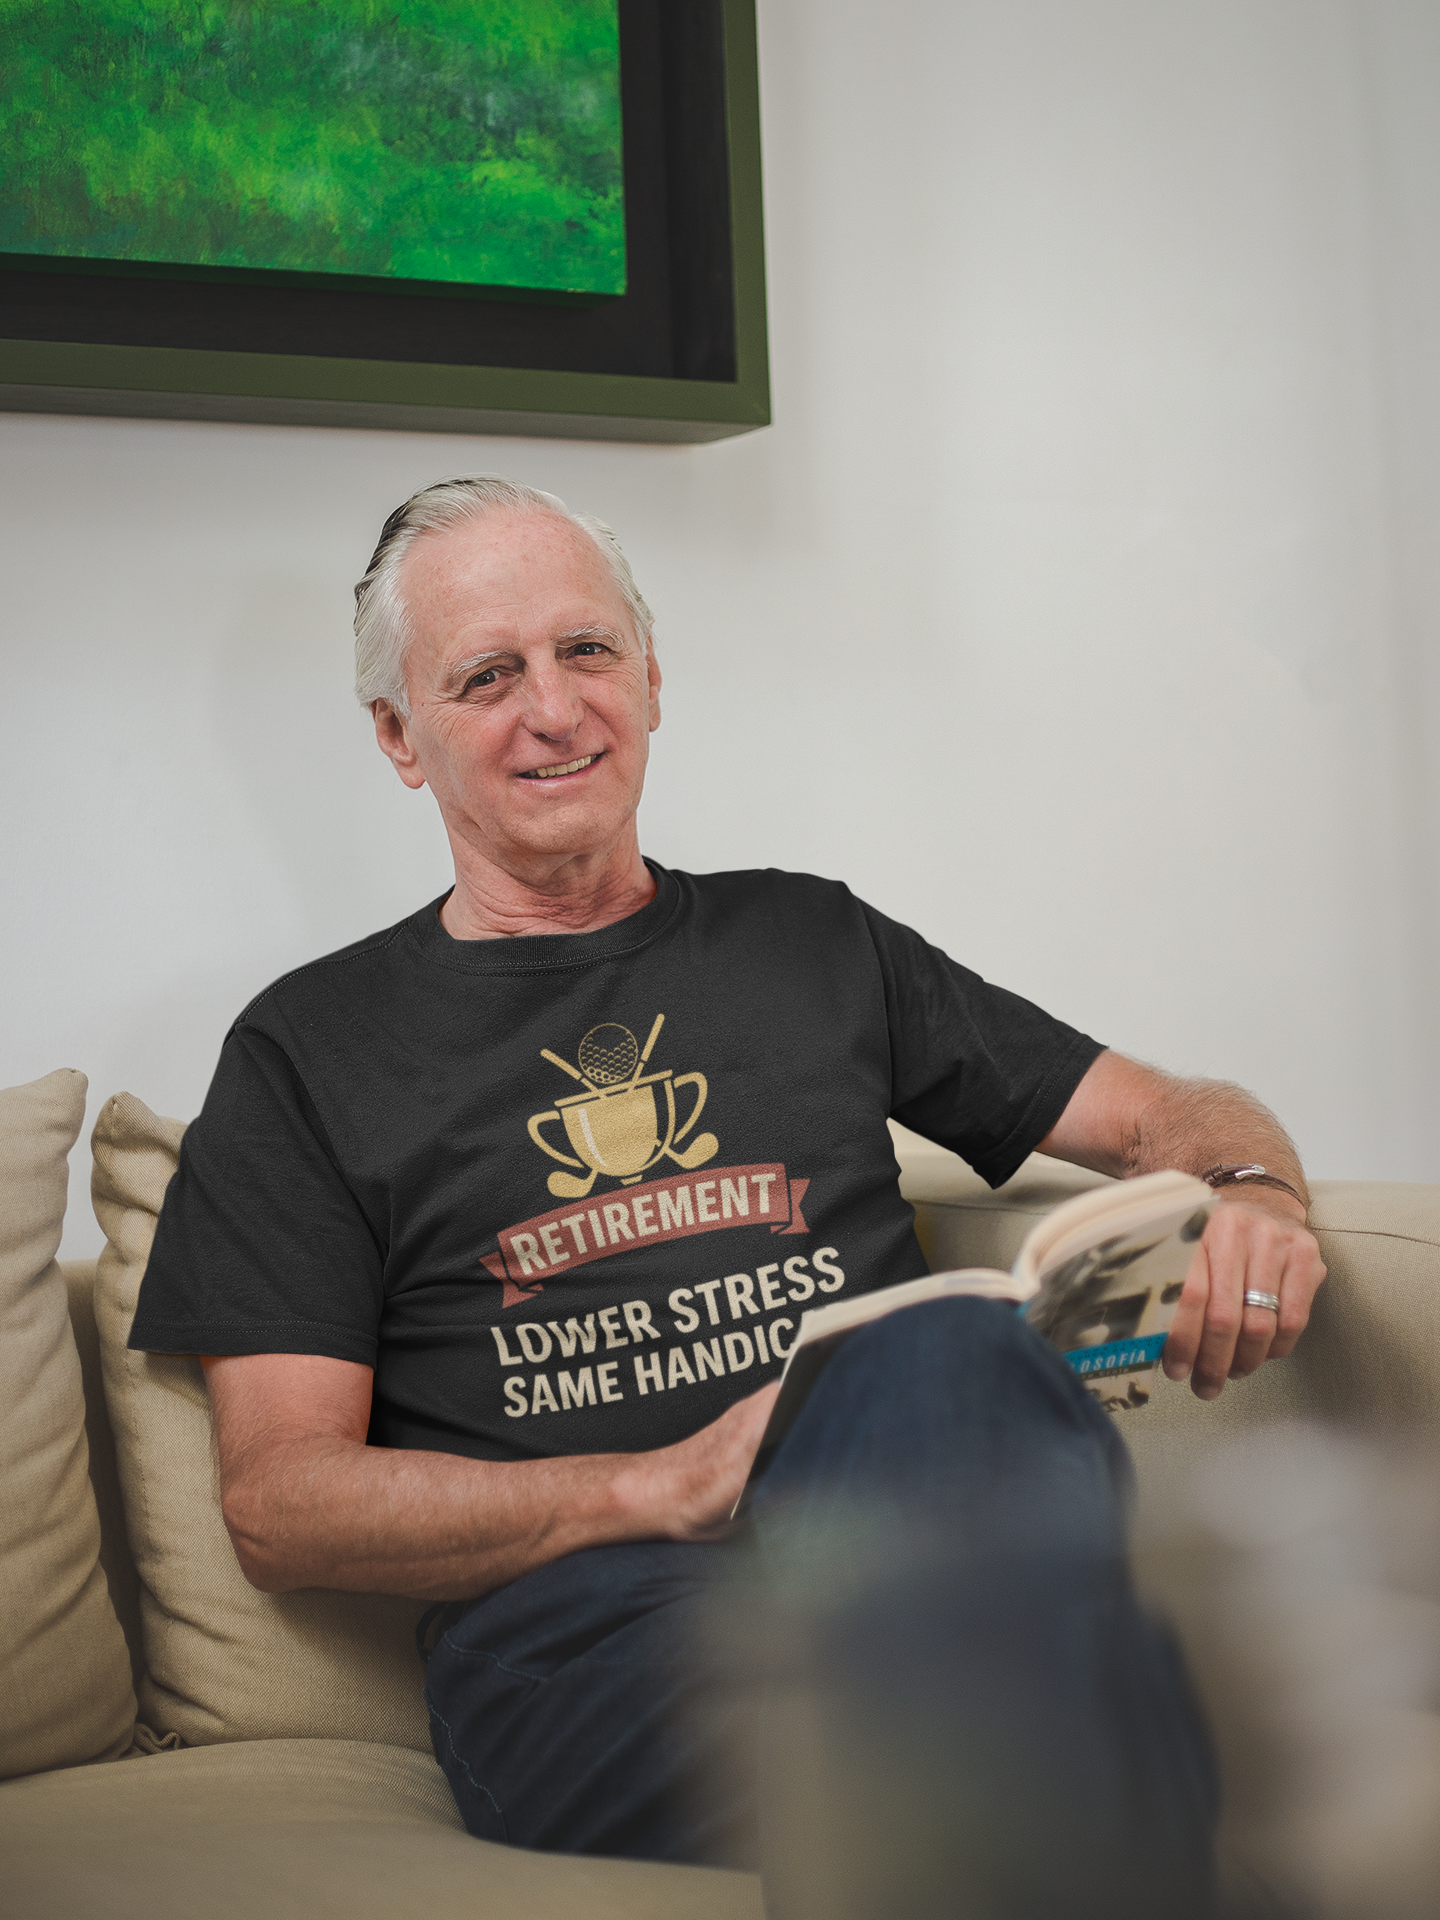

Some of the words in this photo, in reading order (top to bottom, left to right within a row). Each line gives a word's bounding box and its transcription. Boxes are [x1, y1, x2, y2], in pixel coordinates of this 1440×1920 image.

[509, 1172, 777, 1276] RETIREMENT
[491, 1300, 661, 1366] LOWER
[668, 1247, 845, 1333] STRESS
[503, 1362, 623, 1418] SAME
[634, 1317, 798, 1395] HANDIC
[1071, 1348, 1146, 1374] OSOFÍA
